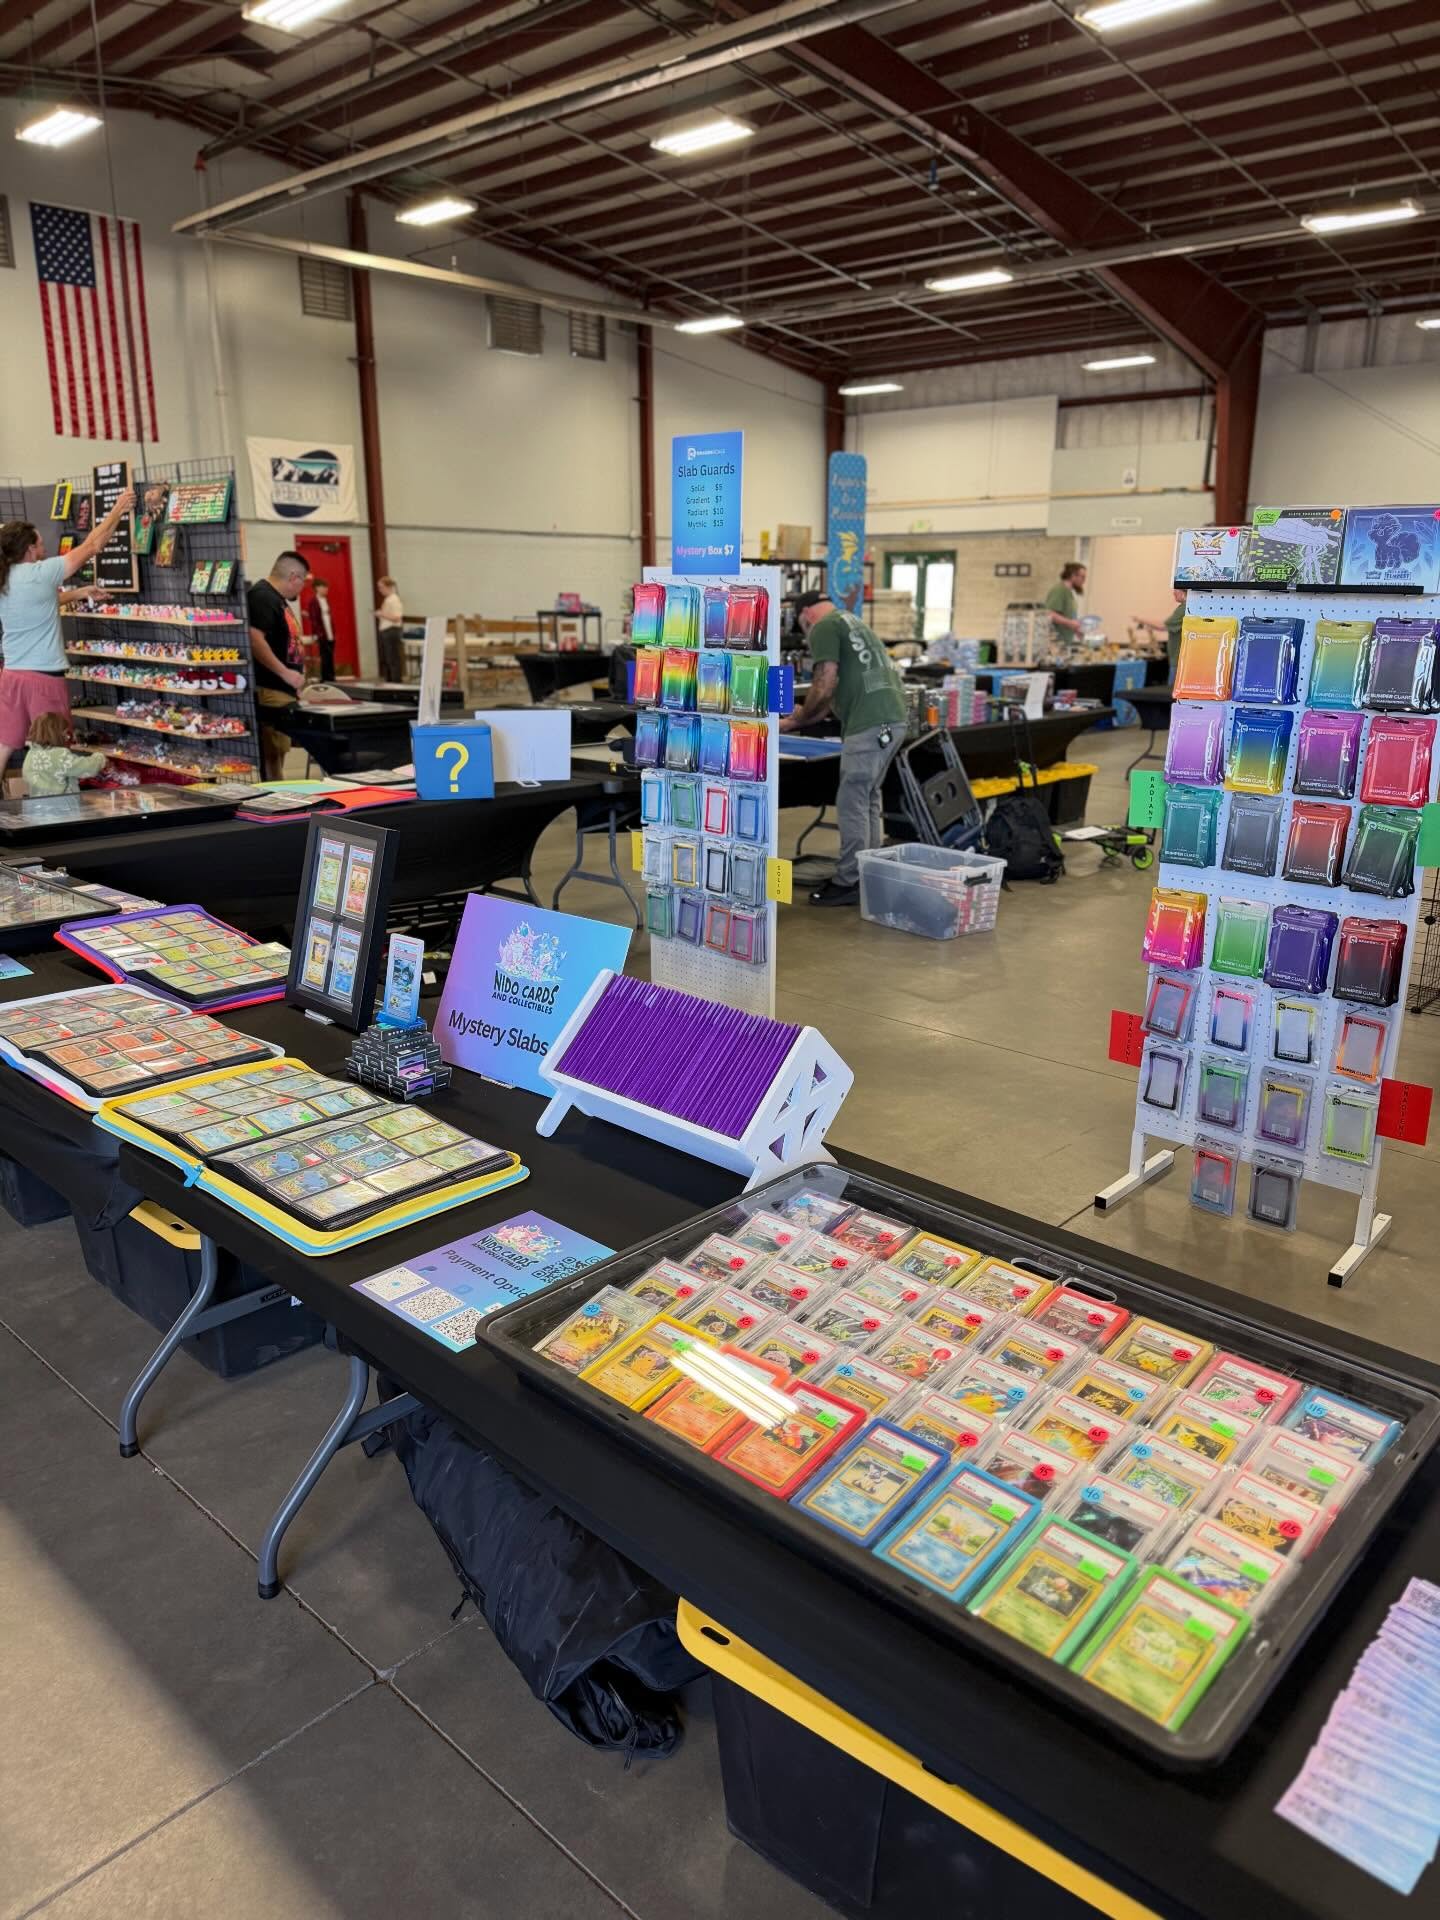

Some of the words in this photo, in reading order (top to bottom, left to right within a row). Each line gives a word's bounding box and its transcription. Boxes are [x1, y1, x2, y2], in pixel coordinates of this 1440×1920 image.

[678, 464, 697, 478] Slab
[700, 462, 735, 476] Guards
[685, 496, 710, 505] Gradient
[687, 521, 707, 529] Mythic
[676, 546, 706, 558] Mystery
[707, 545, 723, 556] Box
[724, 544, 735, 557] $7
[435, 741, 470, 793] ?
[1147, 775, 1156, 822] RADIANT
[493, 970, 520, 996] NIDO
[522, 983, 559, 1006] CARDS
[492, 991, 507, 1003] AND
[508, 995, 553, 1015] COLLECTIBLES
[448, 1008, 507, 1047] Mystery
[507, 1027, 549, 1057] Slabs
[479, 1234, 503, 1252] NIDO
[501, 1247, 540, 1268] CARDS
[484, 1247, 523, 1271] COLLECTIBLES
[442, 1248, 498, 1280] Payment
[847, 1384, 871, 1400] TRAINER
[1135, 1446, 1148, 1456] 40
[1086, 1487, 1101, 1500] 40
[1279, 1521, 1299, 1535] 125
